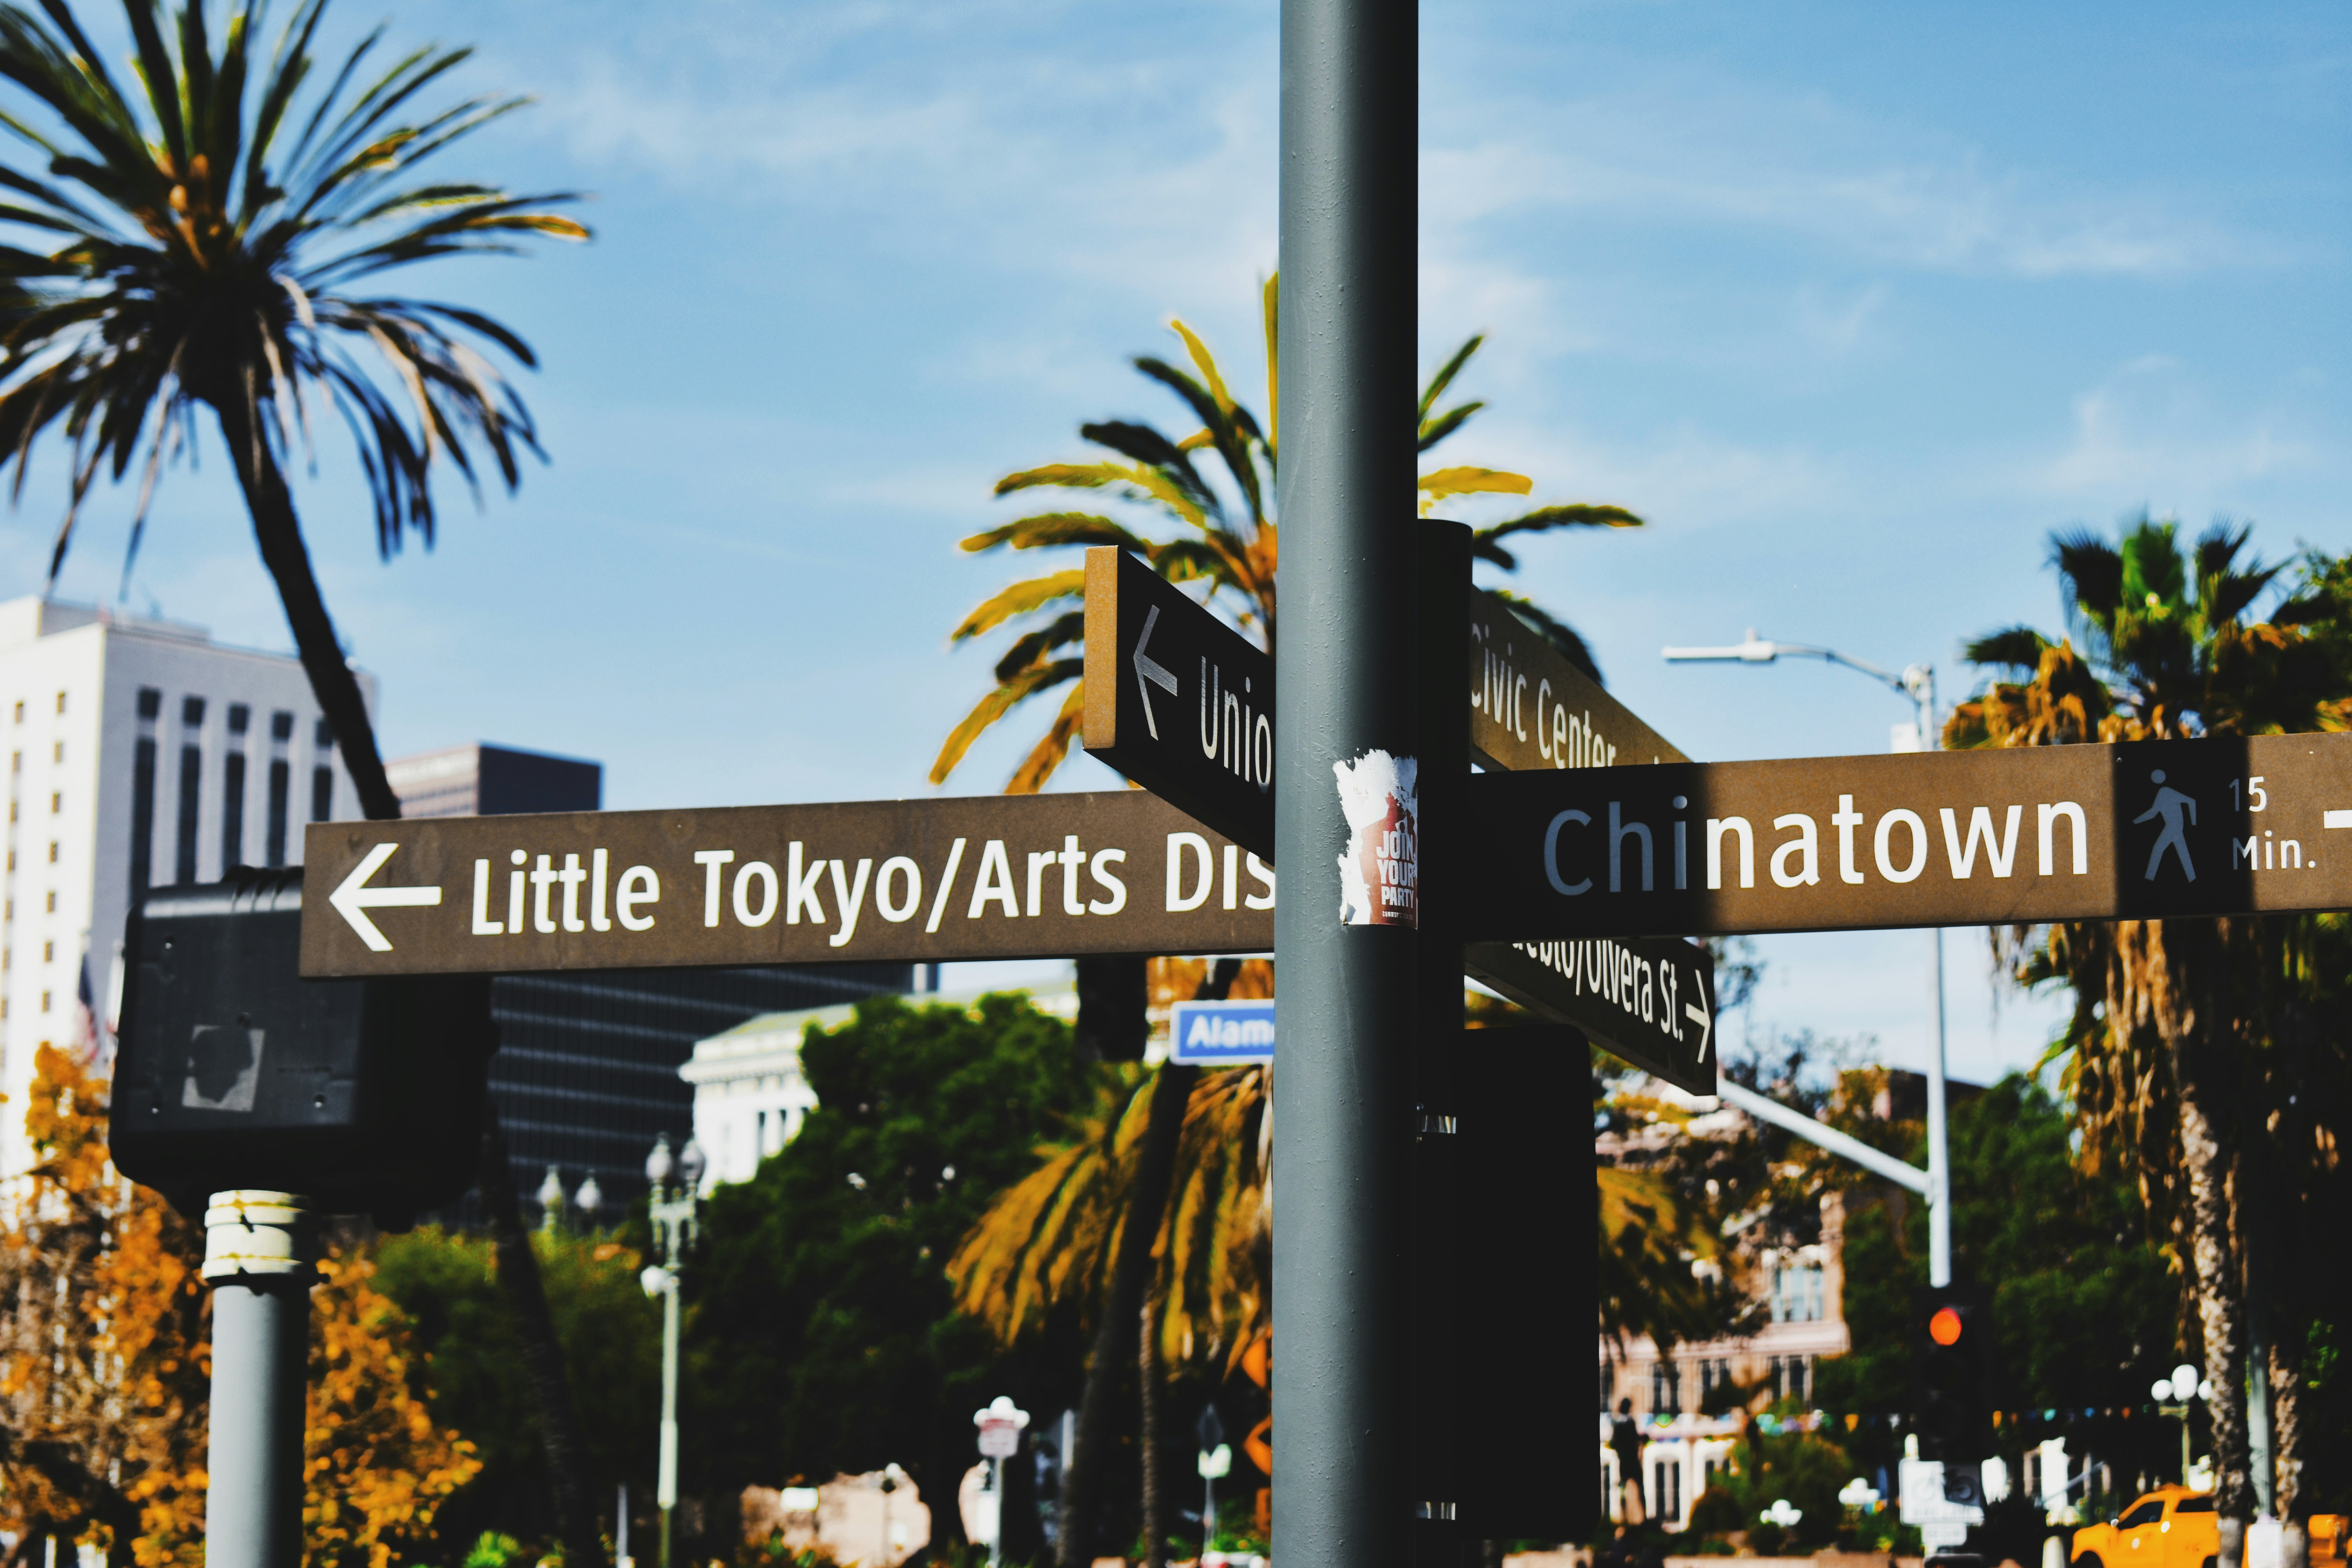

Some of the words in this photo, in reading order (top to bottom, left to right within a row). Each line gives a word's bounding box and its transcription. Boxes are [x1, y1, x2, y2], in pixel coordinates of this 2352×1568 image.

[1201, 656, 1272, 794] Unio
[2229, 776, 2267, 812] 15
[1376, 830, 1413, 862] JOIN
[1543, 794, 2087, 895] Chinatown
[2233, 830, 2316, 871] Min.
[472, 848, 660, 935] Little
[694, 835, 1127, 947] Tokyo/Arts
[1165, 832, 1275, 912] Dis
[1376, 859, 1414, 888] YOUR
[1381, 886, 1414, 908] PARTY
[1660, 959, 1683, 1042] St.
[1186, 1014, 1275, 1049] Alam
